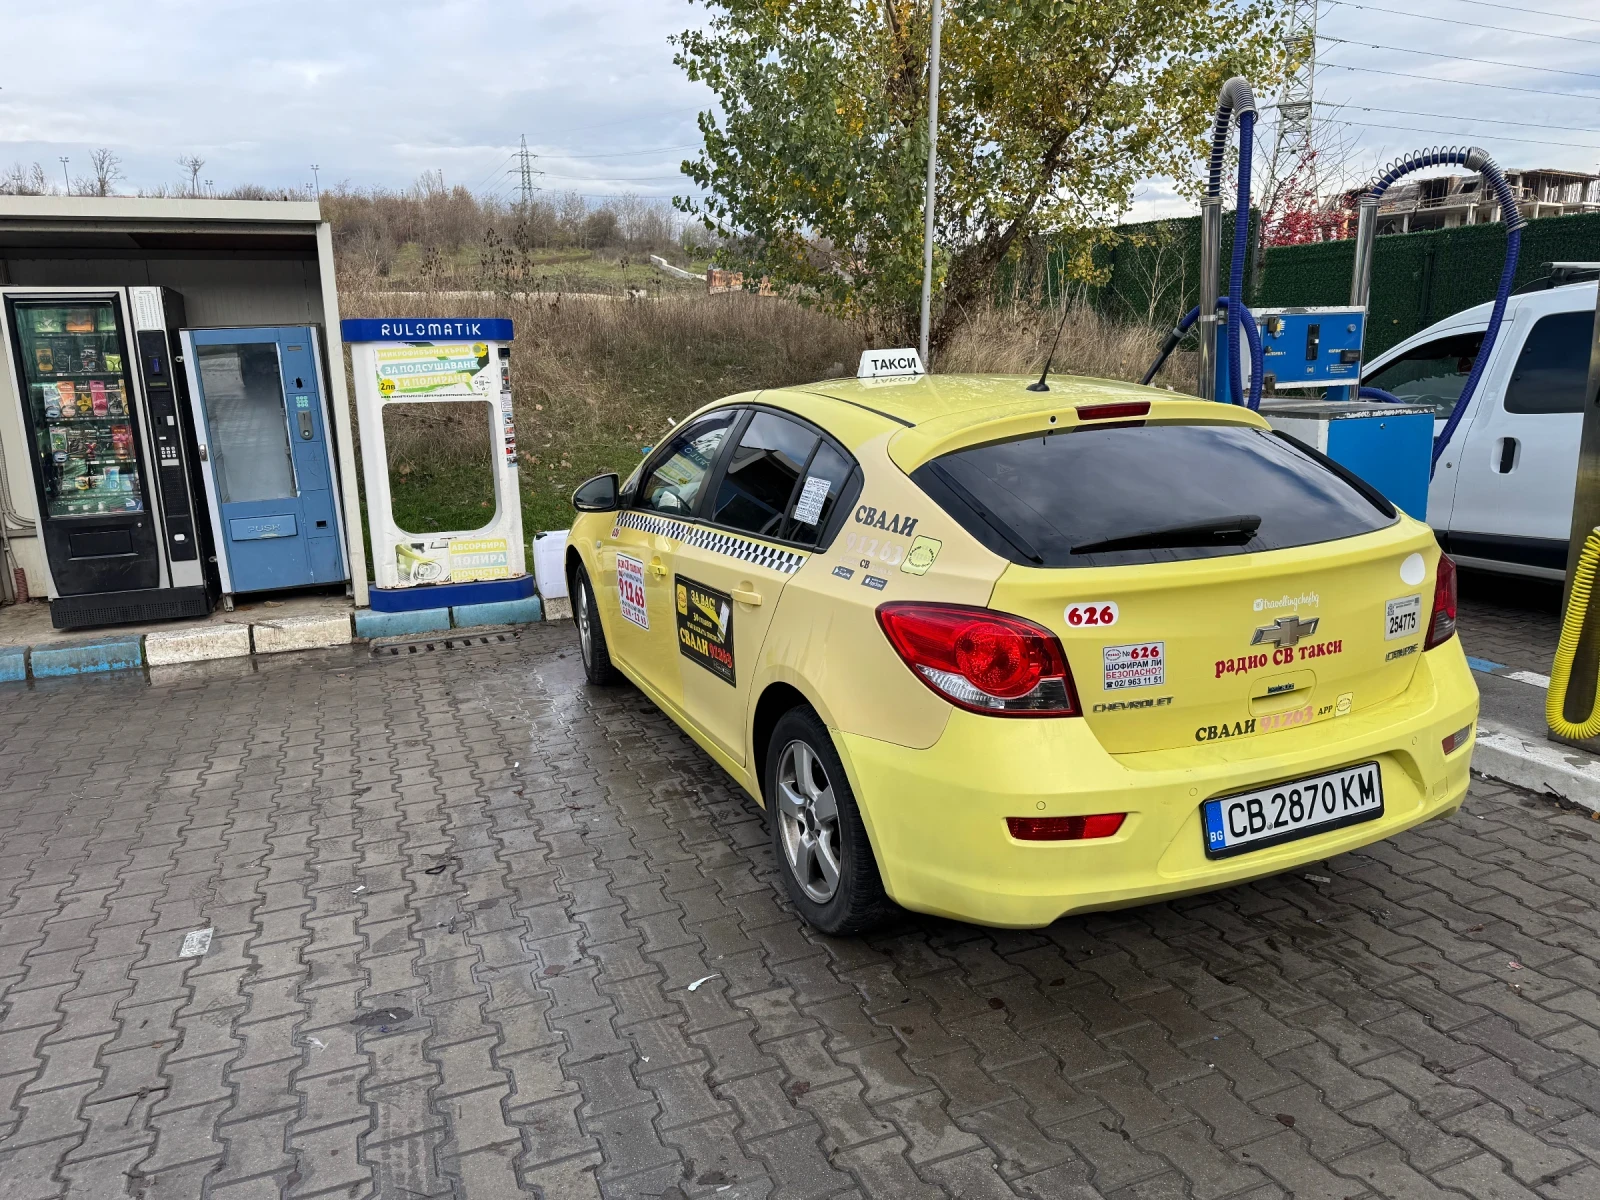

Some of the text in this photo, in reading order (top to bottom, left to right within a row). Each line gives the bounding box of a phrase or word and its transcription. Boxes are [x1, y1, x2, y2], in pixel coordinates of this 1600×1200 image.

[385, 360, 477, 375] ЗА ПОДСУШАВАНЕ
[871, 357, 917, 370] ТАКСИ
[403, 375, 467, 387] И ПОЛИРАНЕ
[247, 523, 281, 534] PUSH
[854, 505, 919, 537] СВАЛИ
[451, 541, 505, 551] АБСОРБИРА
[846, 532, 905, 566] 91263
[453, 568, 506, 578] ПОЧИСТВА
[691, 589, 699, 605] ЗА
[1068, 605, 1114, 626] 626
[1389, 611, 1416, 634] 254775
[679, 627, 709, 657] СВАЛИ
[1105, 659, 1162, 672] ШОФИРАМ ЛИ
[1215, 640, 1343, 678] радио СВ такси
[1106, 667, 1162, 679] БЕЗОПАСНО?
[1114, 679, 1126, 687] 02/
[1127, 677, 1141, 686] 963
[1154, 675, 1162, 683] 51
[1093, 696, 1174, 713] CHEVROLET
[1195, 718, 1256, 742] СВАЛИ
[1210, 830, 1224, 843] BG
